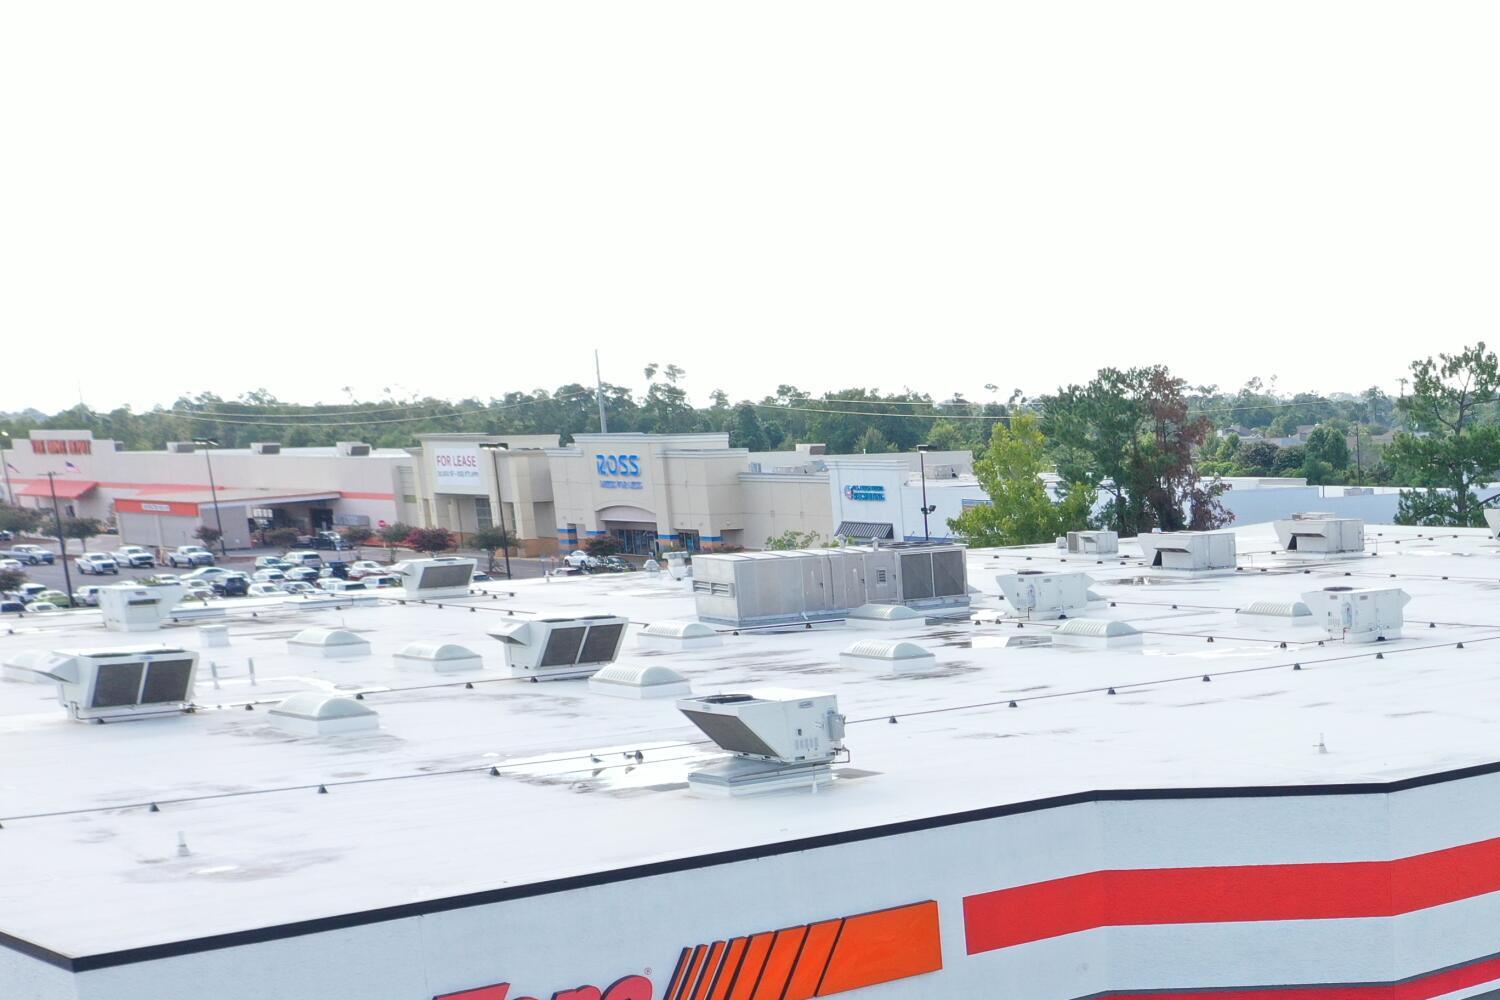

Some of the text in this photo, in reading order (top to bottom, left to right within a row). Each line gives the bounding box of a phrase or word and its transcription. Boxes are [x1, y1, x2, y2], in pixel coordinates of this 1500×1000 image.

[436, 455, 477, 468] FOR LEASE
[595, 454, 641, 477] ROSS
